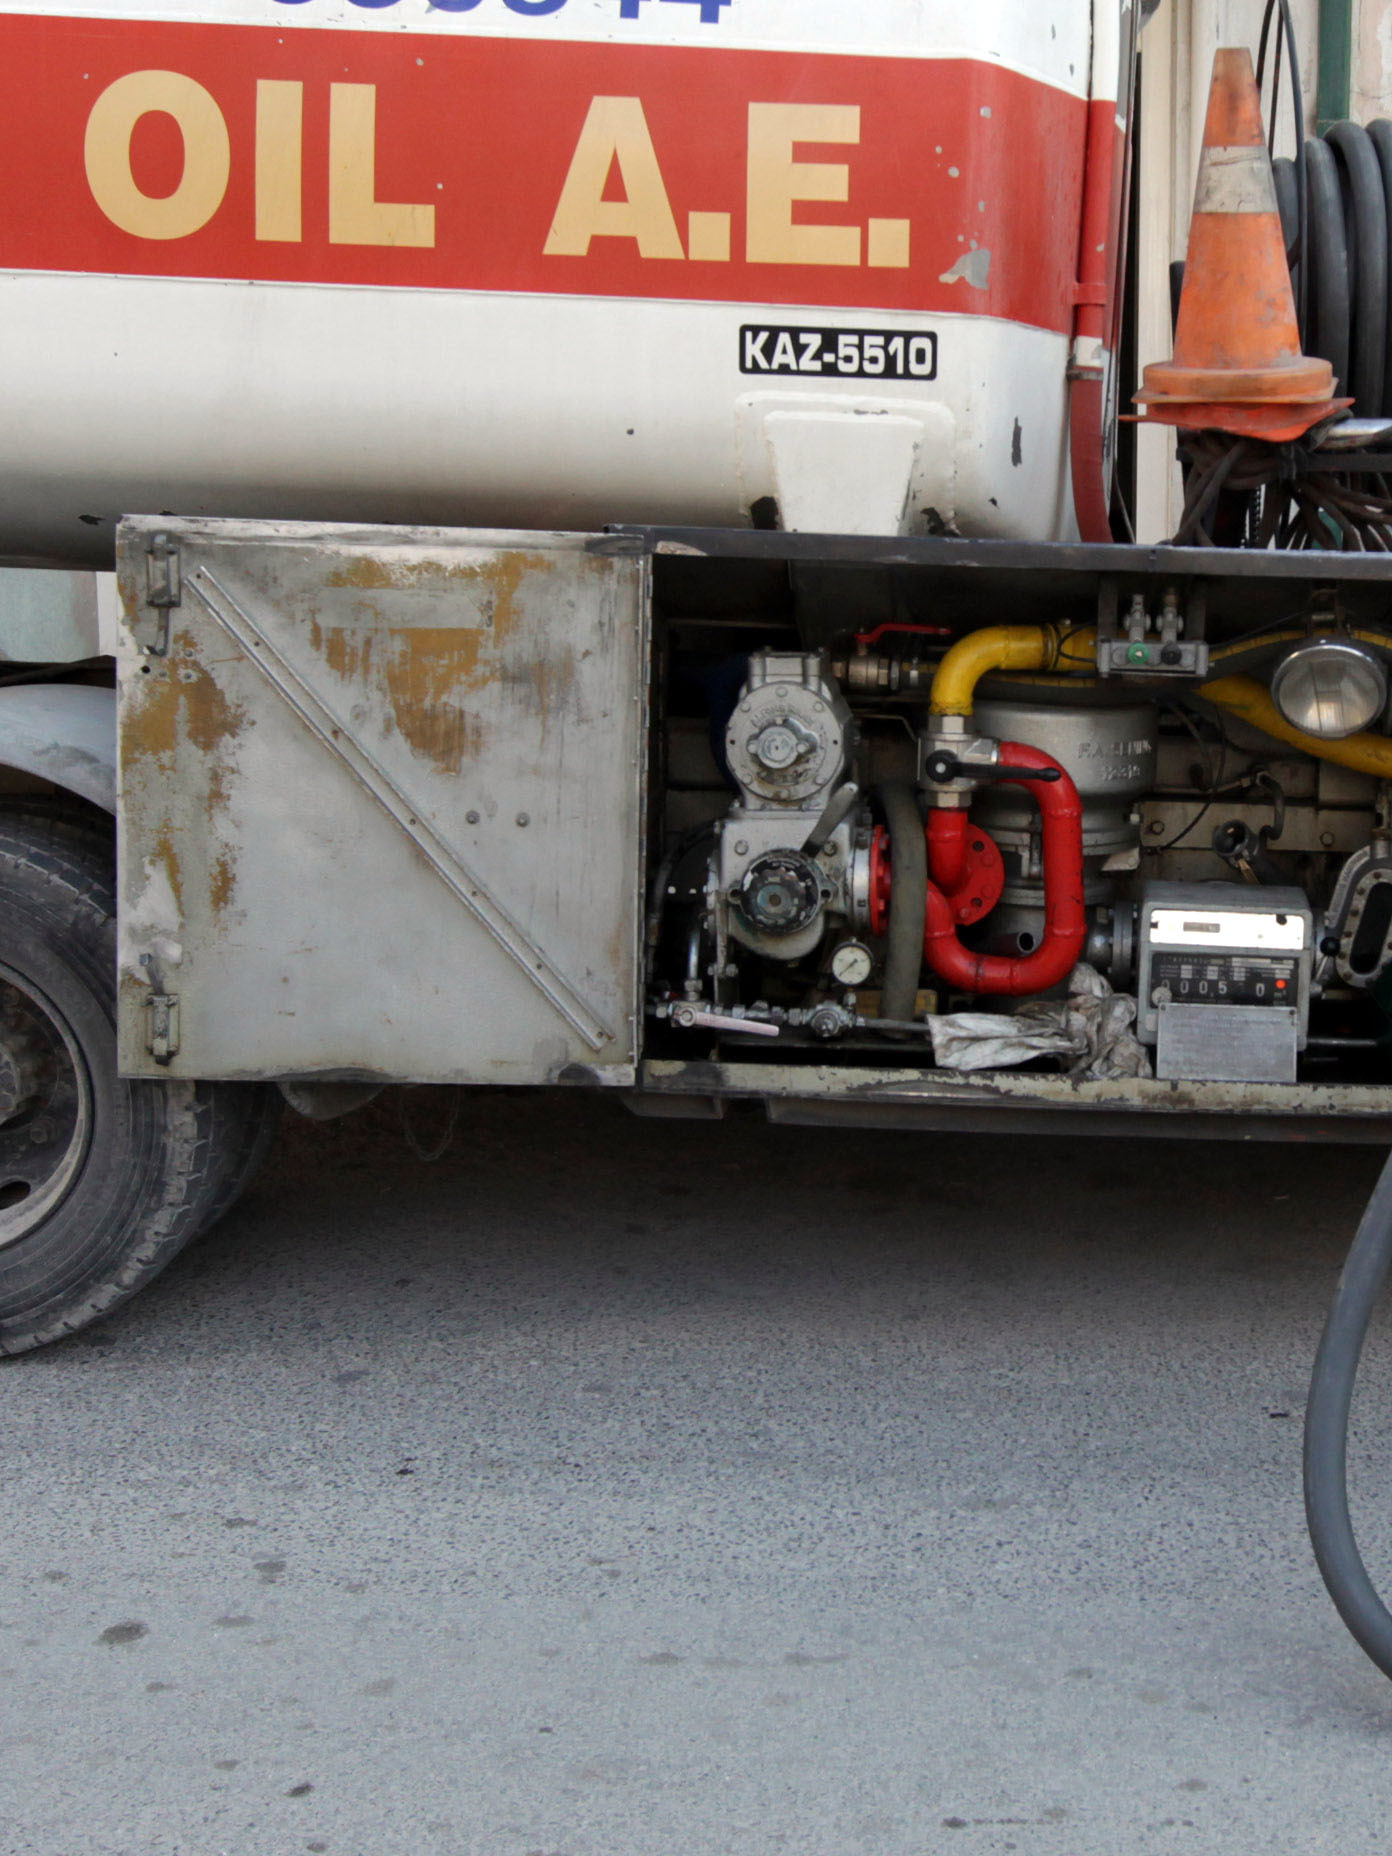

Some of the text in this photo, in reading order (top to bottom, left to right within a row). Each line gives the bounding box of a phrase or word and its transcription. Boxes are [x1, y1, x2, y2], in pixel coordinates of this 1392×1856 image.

[84, 70, 911, 269] OIL A.E.
[745, 330, 933, 376] KAZ-5510
